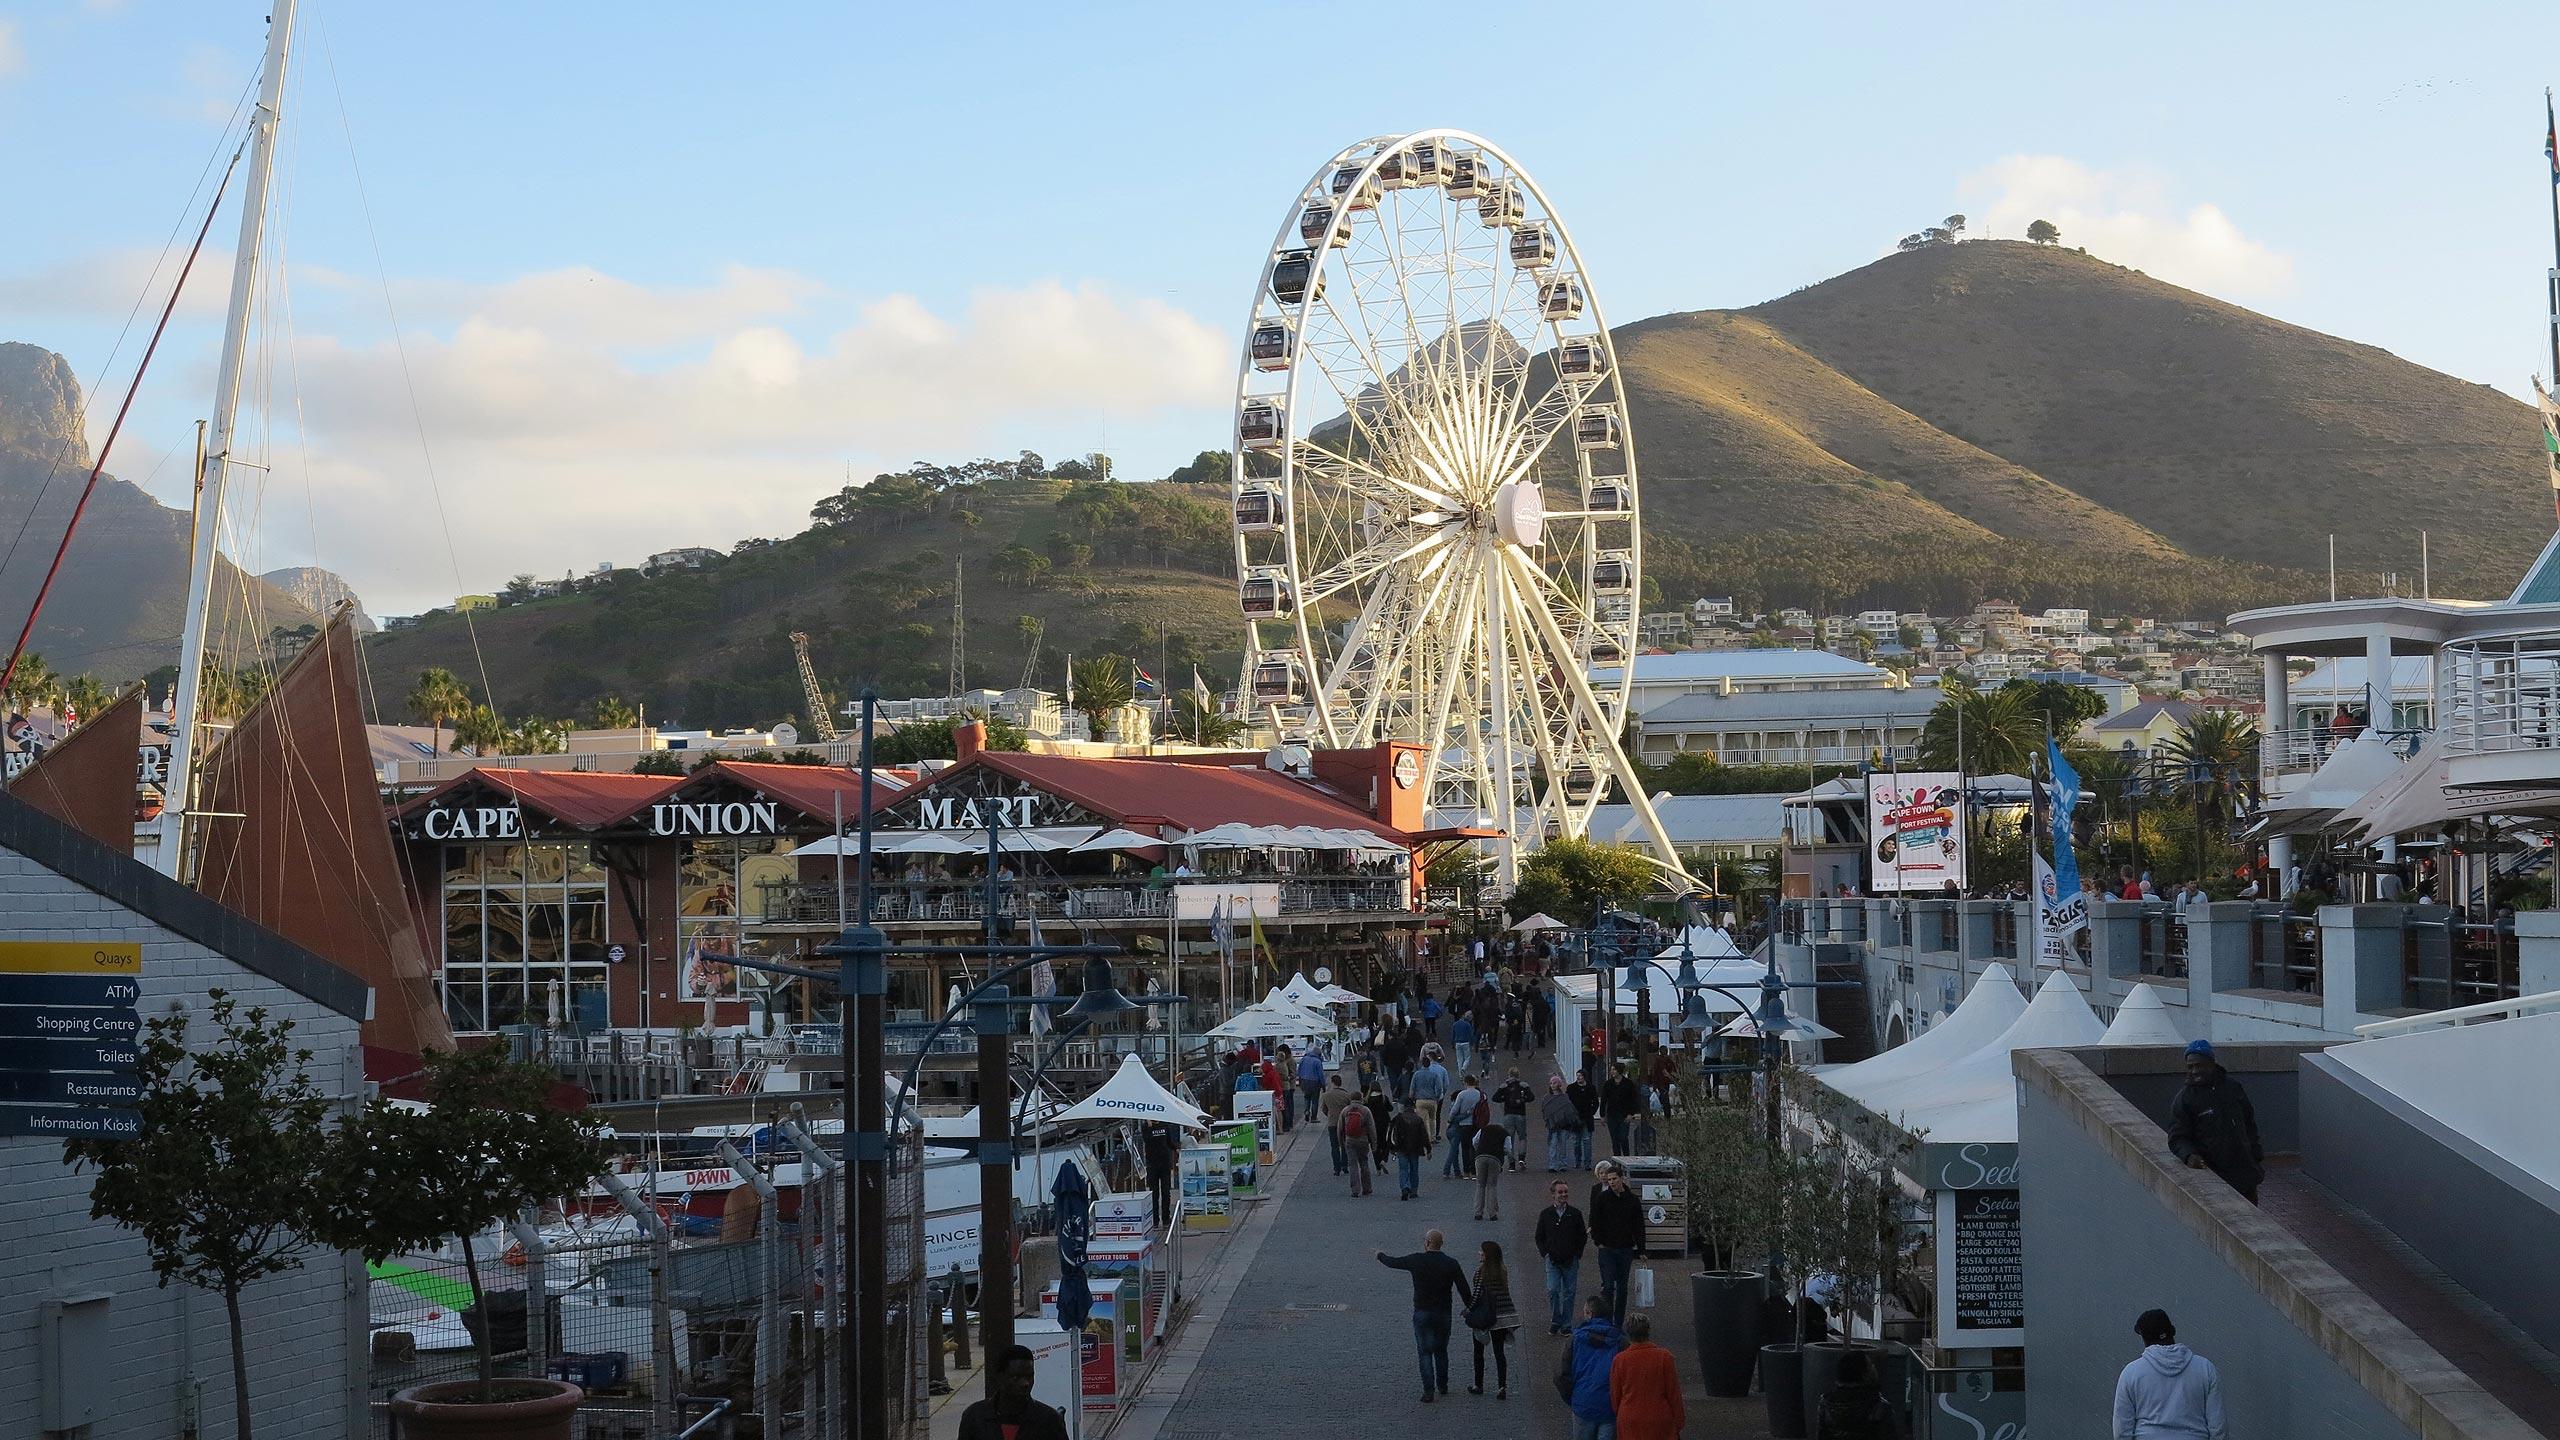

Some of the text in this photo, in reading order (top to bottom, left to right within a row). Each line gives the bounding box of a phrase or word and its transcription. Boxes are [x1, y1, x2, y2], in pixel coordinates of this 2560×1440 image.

[425, 796, 1039, 839] CAPE UNION MART
[1890, 804, 1935, 819] CAPE TOWN
[1901, 816, 1944, 829] PORT FESTIVAL
[94, 951, 132, 967] Quays
[105, 985, 134, 998] ATM
[36, 1016, 135, 1032] Shopping Centre
[96, 1049, 135, 1063] Toilets
[67, 1082, 137, 1096] Restaurants
[1095, 1097, 1165, 1113] bonaqua
[30, 1115, 137, 1132] Information Kiosk
[686, 1169, 730, 1185] DAWN
[1961, 1221, 1983, 1230] LAMB
[1960, 1230, 1976, 1239] BBQ
[1977, 1230, 2006, 1238] ORANGE
[1960, 1239, 1982, 1247] LARGE
[930, 1246, 957, 1254] LUXURY
[1960, 1247, 1993, 1255] SEAFOOD
[1960, 1257, 1984, 1265] PASTA
[1960, 1266, 1991, 1274] SEAFOOD
[1994, 1274, 2022, 1282] PLATTER
[1961, 1291, 2024, 1301] FRESH OYSTERS
